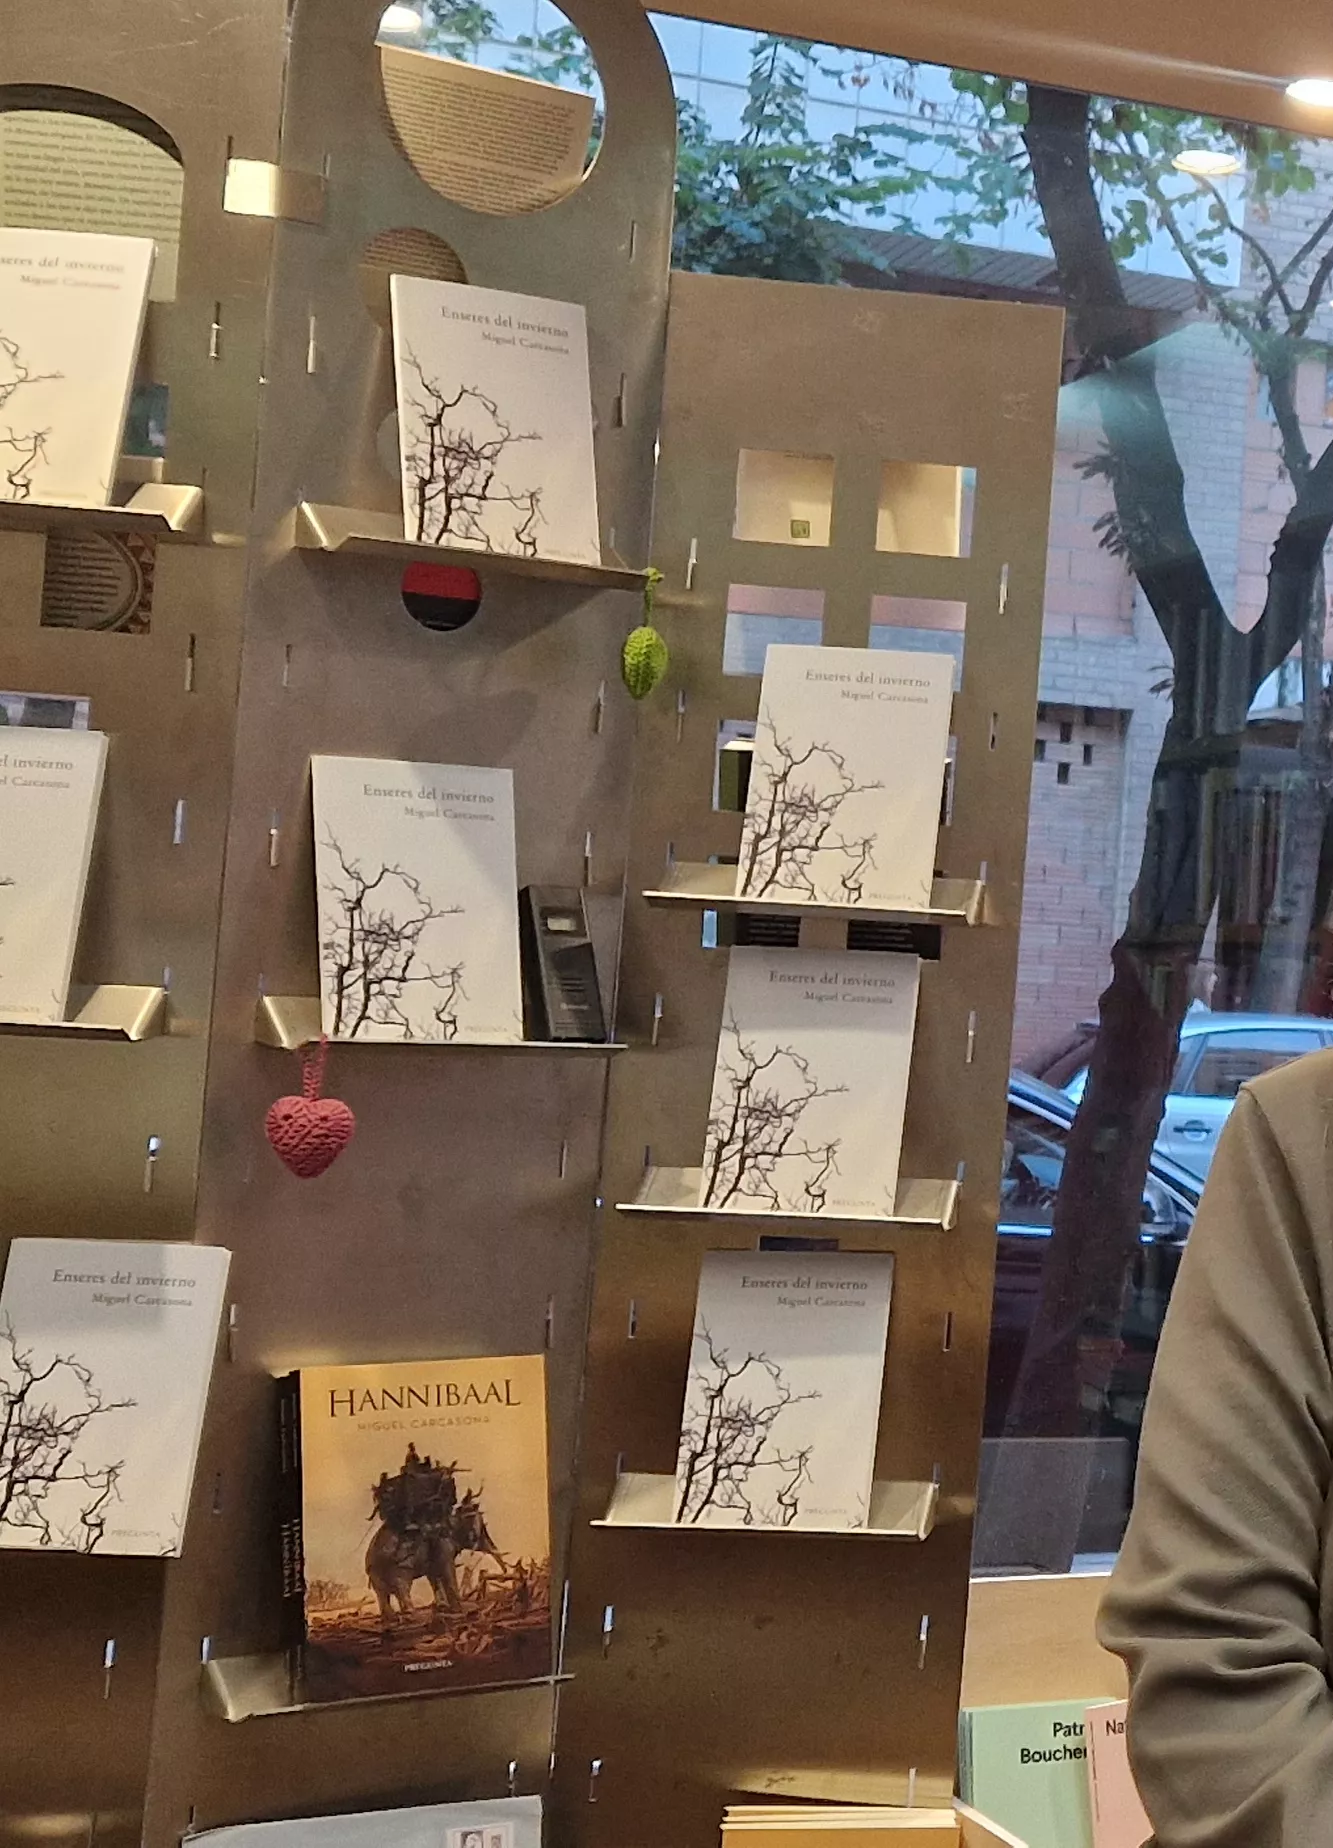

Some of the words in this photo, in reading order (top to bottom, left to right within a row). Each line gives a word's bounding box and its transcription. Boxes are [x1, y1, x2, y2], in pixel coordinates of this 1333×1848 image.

[494, 315, 512, 328] del
[517, 320, 569, 337] invierno
[856, 671, 874, 684] del
[879, 674, 930, 687] invierno
[13, 758, 73, 770] invierno
[363, 784, 413, 799] Enseres
[417, 786, 437, 800] del
[441, 791, 494, 804] invierno
[820, 972, 838, 984] del
[843, 974, 895, 988] invierno
[53, 1269, 105, 1283] Enseres
[110, 1271, 132, 1285] del
[136, 1277, 196, 1288] invierno
[741, 1276, 788, 1288] Enseres
[792, 1277, 811, 1289] del
[815, 1279, 868, 1290] invierno
[328, 1378, 521, 1418] HANNIBAAL
[410, 1415, 490, 1428] CARCASONA
